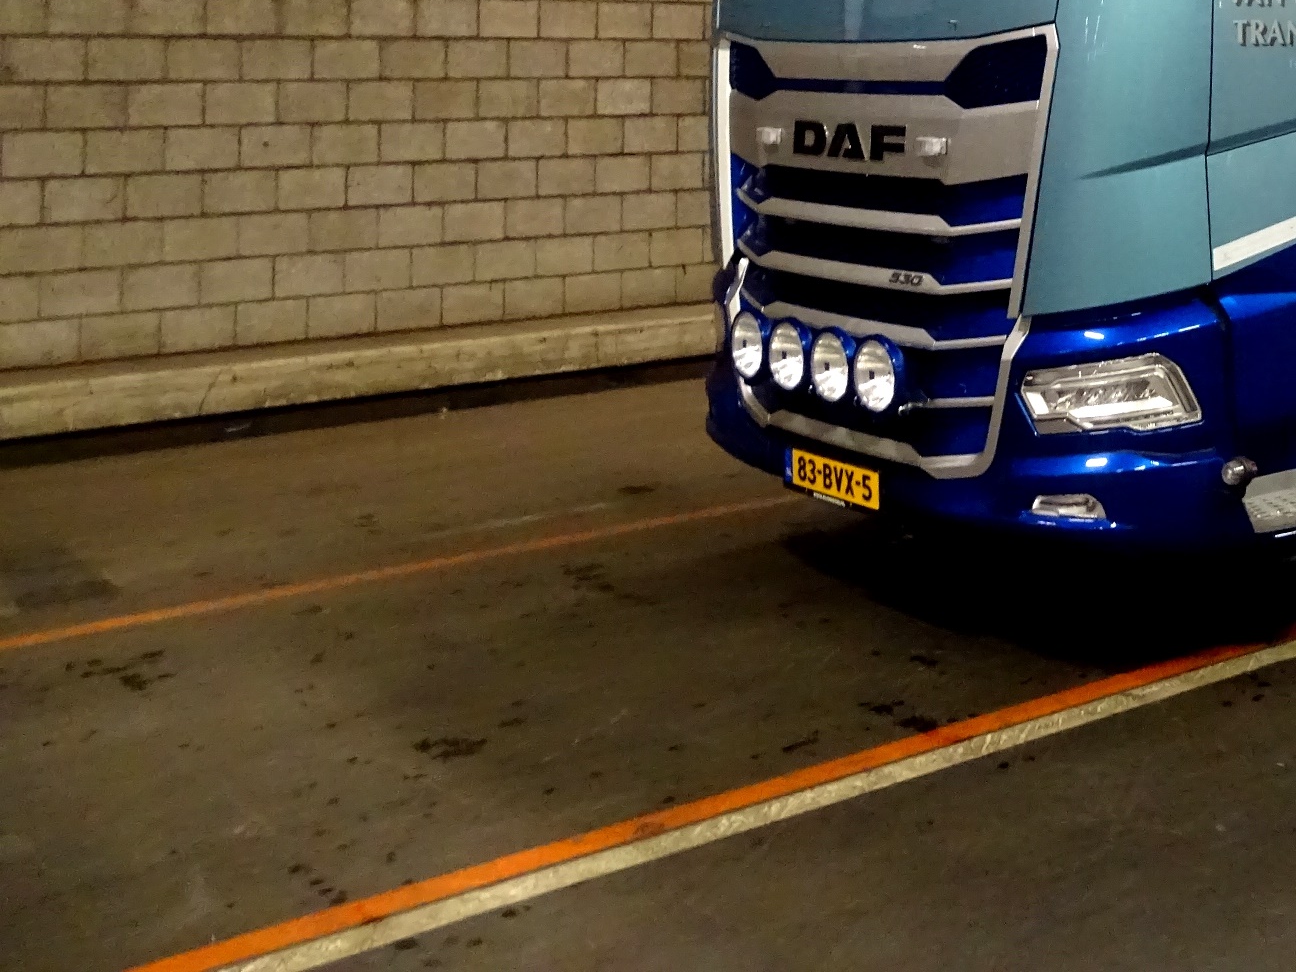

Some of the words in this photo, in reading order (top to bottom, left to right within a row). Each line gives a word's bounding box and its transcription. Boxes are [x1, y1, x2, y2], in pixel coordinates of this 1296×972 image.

[793, 120, 906, 161] DAF
[889, 272, 923, 286] 530
[797, 456, 872, 501] 83-BVX-5
